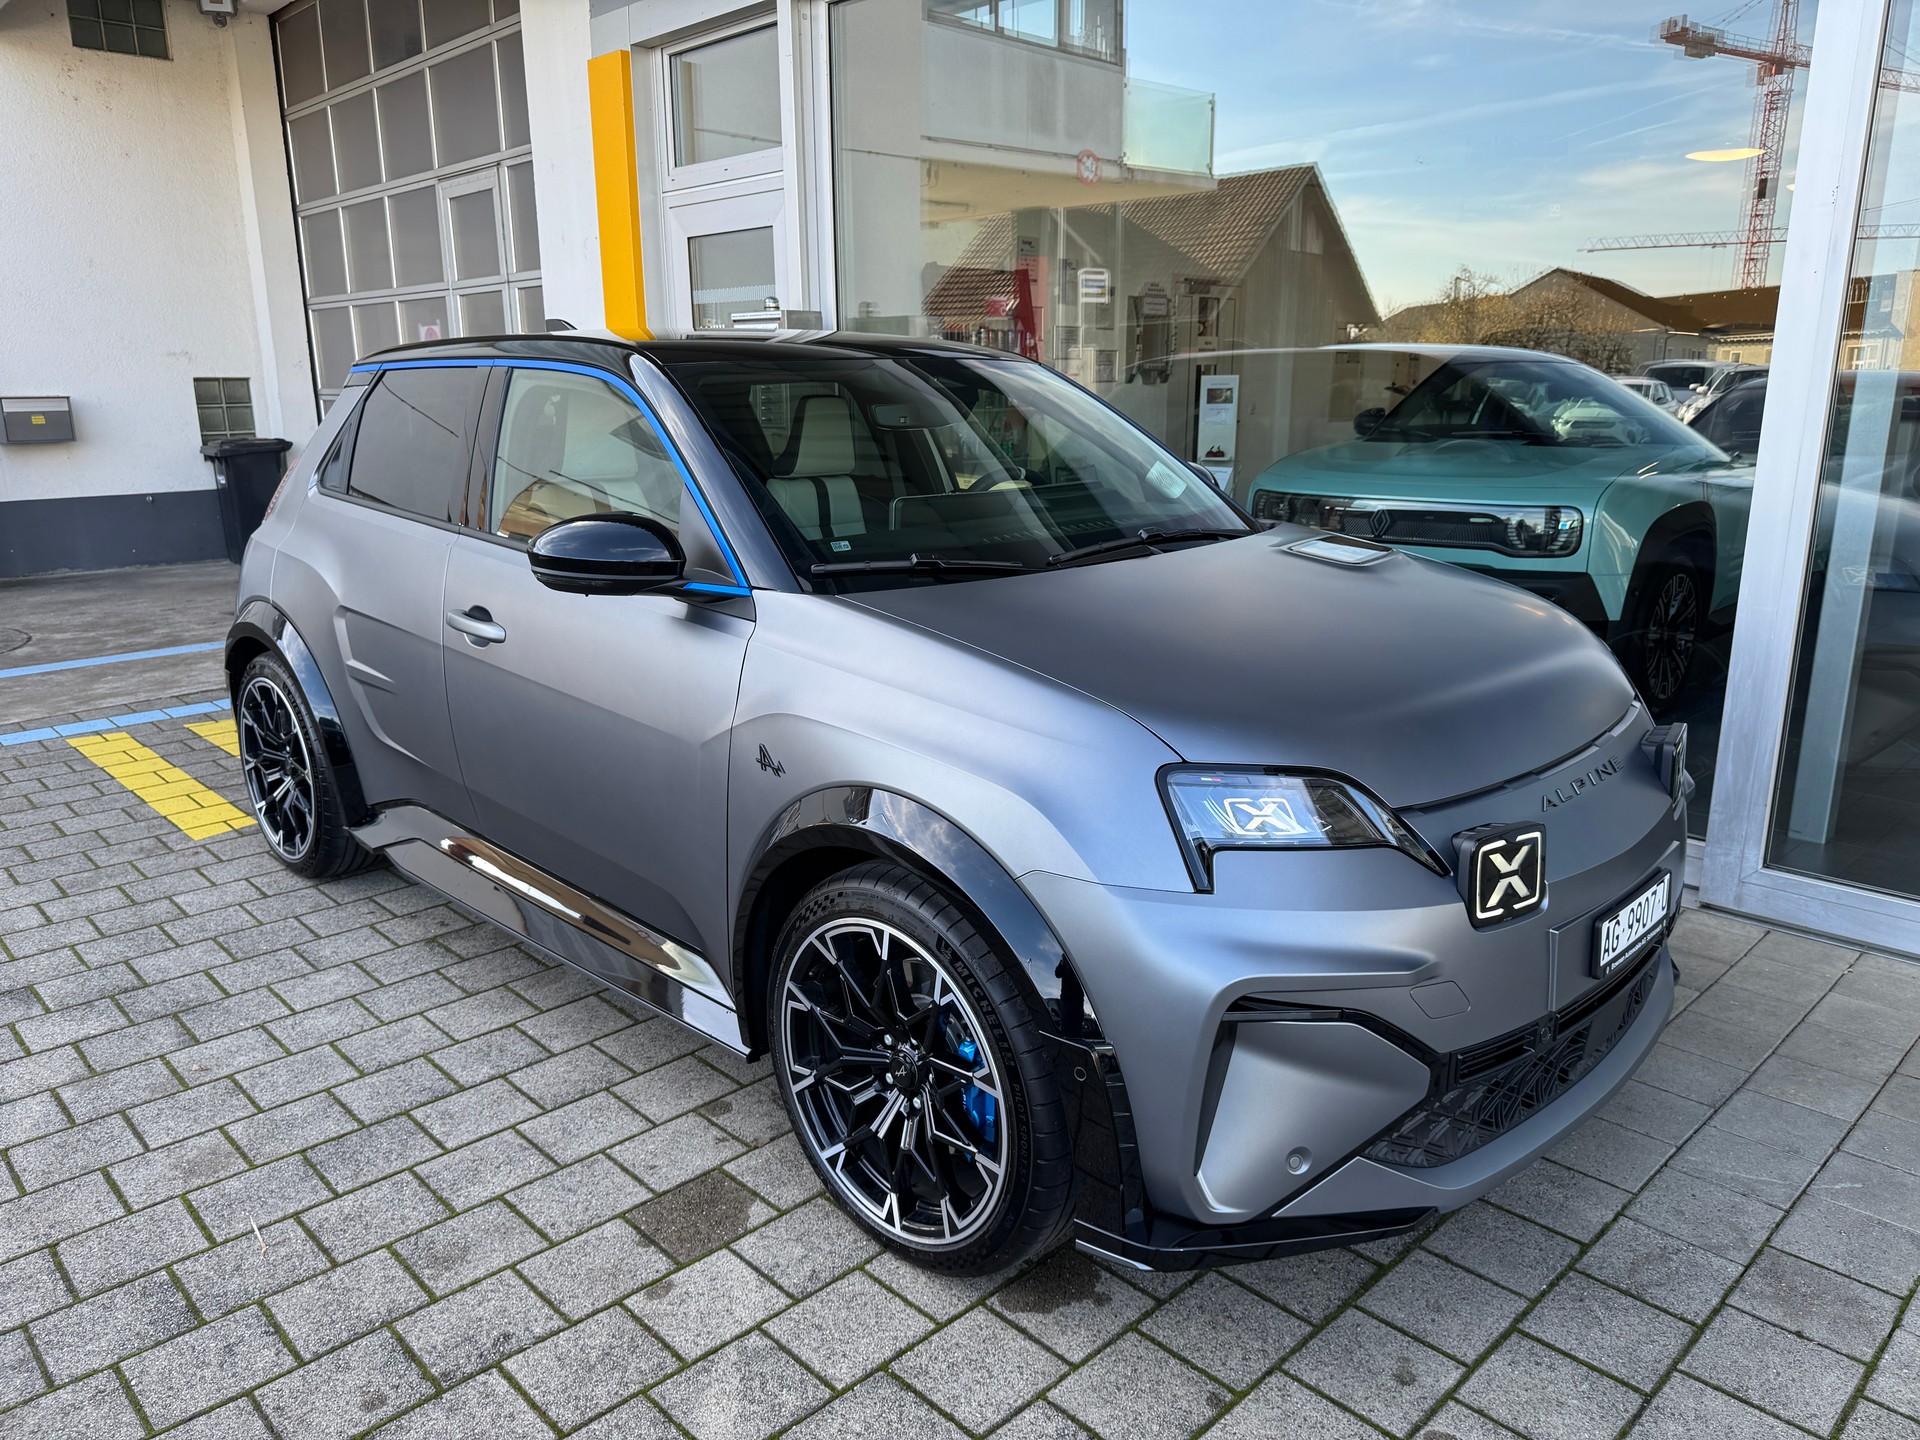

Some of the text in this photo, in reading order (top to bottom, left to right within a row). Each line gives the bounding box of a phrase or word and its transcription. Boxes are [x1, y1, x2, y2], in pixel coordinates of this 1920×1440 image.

[1542, 755, 1624, 812] ALPINE
[952, 960, 1016, 1067] MICHELIN
[1012, 1083, 1026, 1121] PILOT
